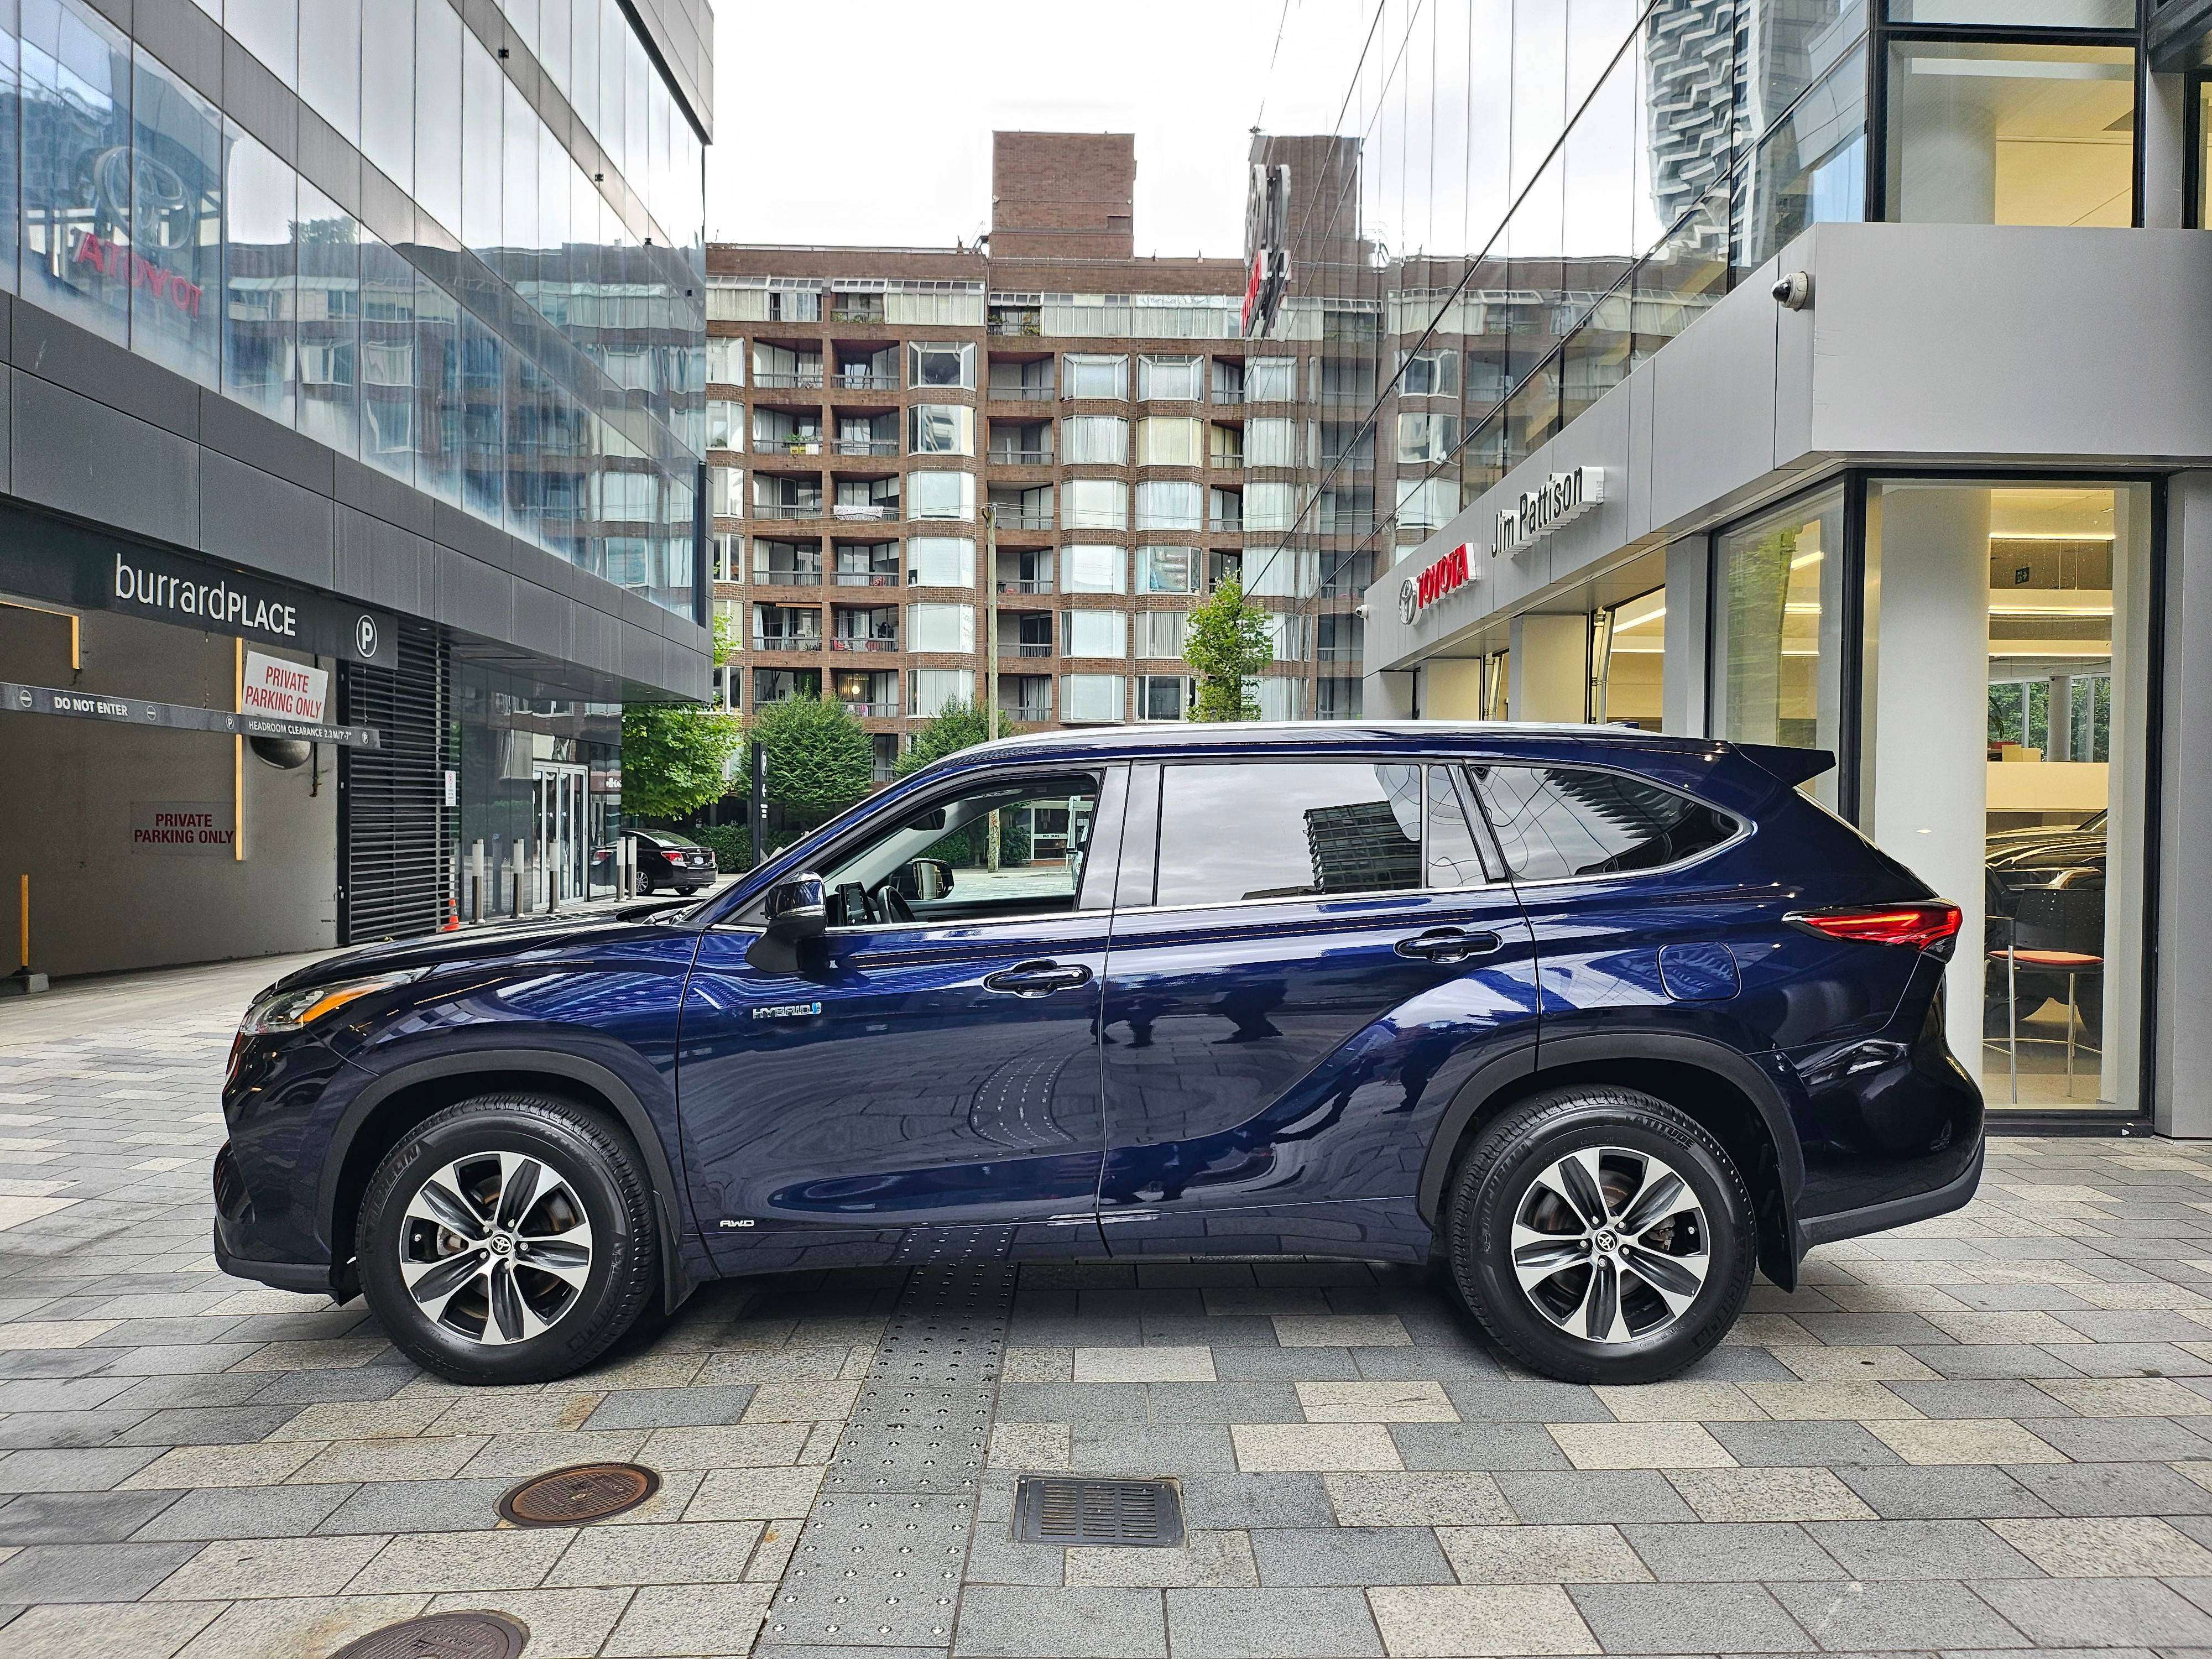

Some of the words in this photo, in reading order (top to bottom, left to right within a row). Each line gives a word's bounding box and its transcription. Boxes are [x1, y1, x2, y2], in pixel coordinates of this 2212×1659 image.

[1491, 510, 1514, 559] Jim
[1520, 467, 1583, 541] Pattison
[1416, 542, 1469, 609] TOYOTA
[115, 553, 296, 637] burrardPLACE
[265, 666, 309, 693] PRIVATE
[54, 696, 71, 710] DO
[73, 698, 95, 712] NOT
[97, 702, 128, 717] ENTER
[245, 685, 293, 713] PARKING
[296, 697, 322, 719] ONLY
[249, 721, 286, 734] HEADROOM
[288, 725, 322, 738] CLEARANCE
[155, 813, 212, 827] PRIVATE
[134, 830, 194, 843] PARKING
[199, 830, 234, 844] ONLY
[753, 1004, 811, 1019] HYBRID
